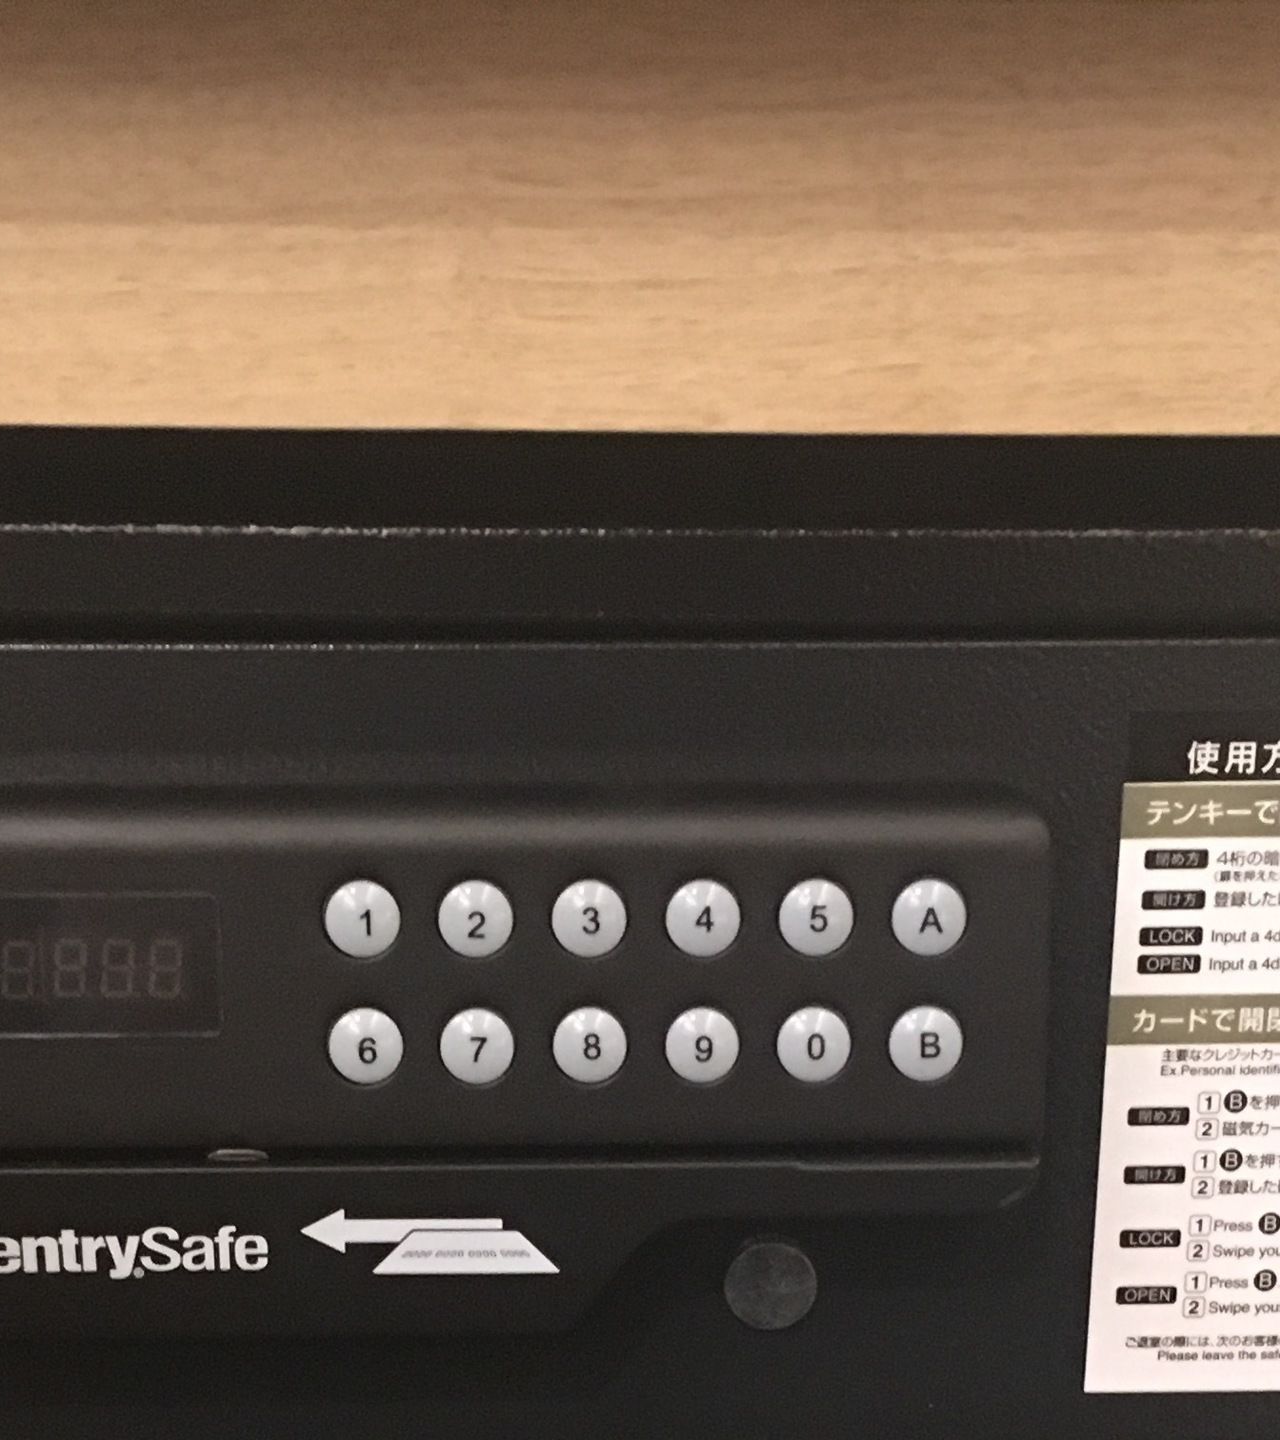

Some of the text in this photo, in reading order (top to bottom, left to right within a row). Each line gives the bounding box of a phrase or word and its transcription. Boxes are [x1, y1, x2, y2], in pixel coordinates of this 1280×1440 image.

[359, 905, 943, 939] 1 2 3 4 5 A
[1149, 929, 1197, 944] LOCK
[1211, 930, 1247, 945] Input
[1250, 931, 1260, 942] a
[1145, 956, 1196, 972] OPEN
[1208, 957, 1245, 973] Input
[1248, 959, 1258, 970] a
[358, 1037, 378, 1064] 6
[470, 1036, 488, 1063] 7
[582, 1034, 602, 1061] 8
[694, 1035, 714, 1062] 9
[921, 1033, 941, 1059] B
[1213, 1219, 1253, 1232] Press
[1128, 1231, 1174, 1246] LOCK
[1212, 1245, 1255, 1260] Swipe
[1209, 1276, 1249, 1289] Press
[1124, 1288, 1171, 1303] OPEN
[1208, 1301, 1251, 1316] Swipe
[1157, 1349, 1199, 1361] Please
[1202, 1350, 1234, 1361] leave
[1238, 1349, 1257, 1361] the
